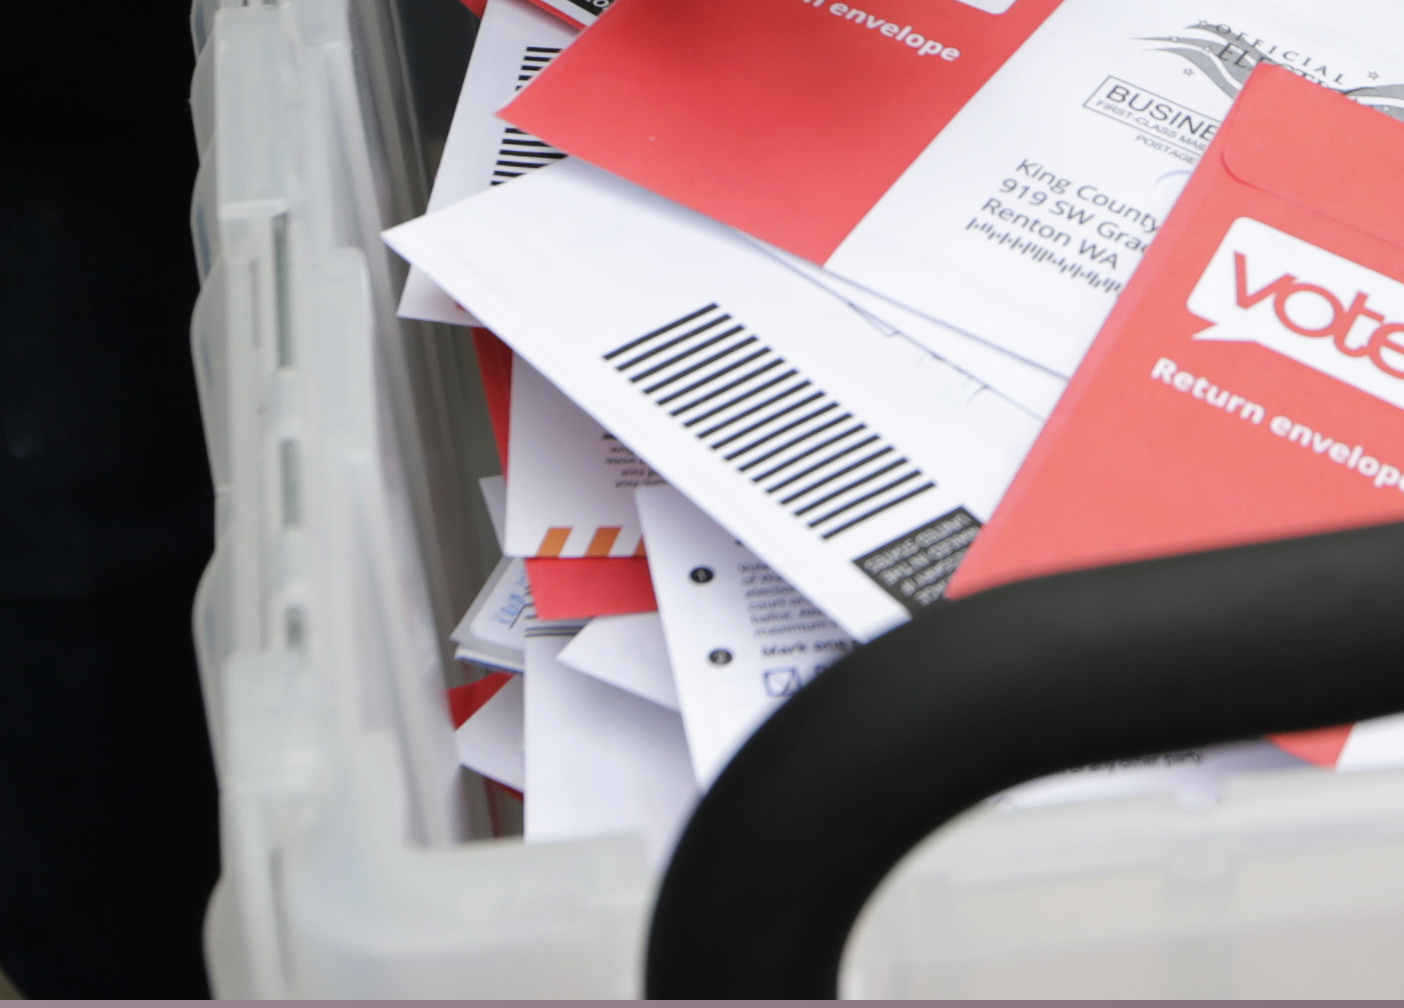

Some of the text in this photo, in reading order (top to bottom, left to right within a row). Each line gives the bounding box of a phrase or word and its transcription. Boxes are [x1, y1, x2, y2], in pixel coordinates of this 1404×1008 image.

[829, 2, 961, 62] envelope
[1215, 23, 1346, 85] OFFICIAL
[1106, 84, 1220, 142] BUSINE
[999, 178, 1048, 206] 919
[1049, 200, 1095, 226] SW
[1016, 158, 1160, 234] King County
[981, 197, 1119, 270] Renton WA
[1151, 357, 1266, 425] Return
